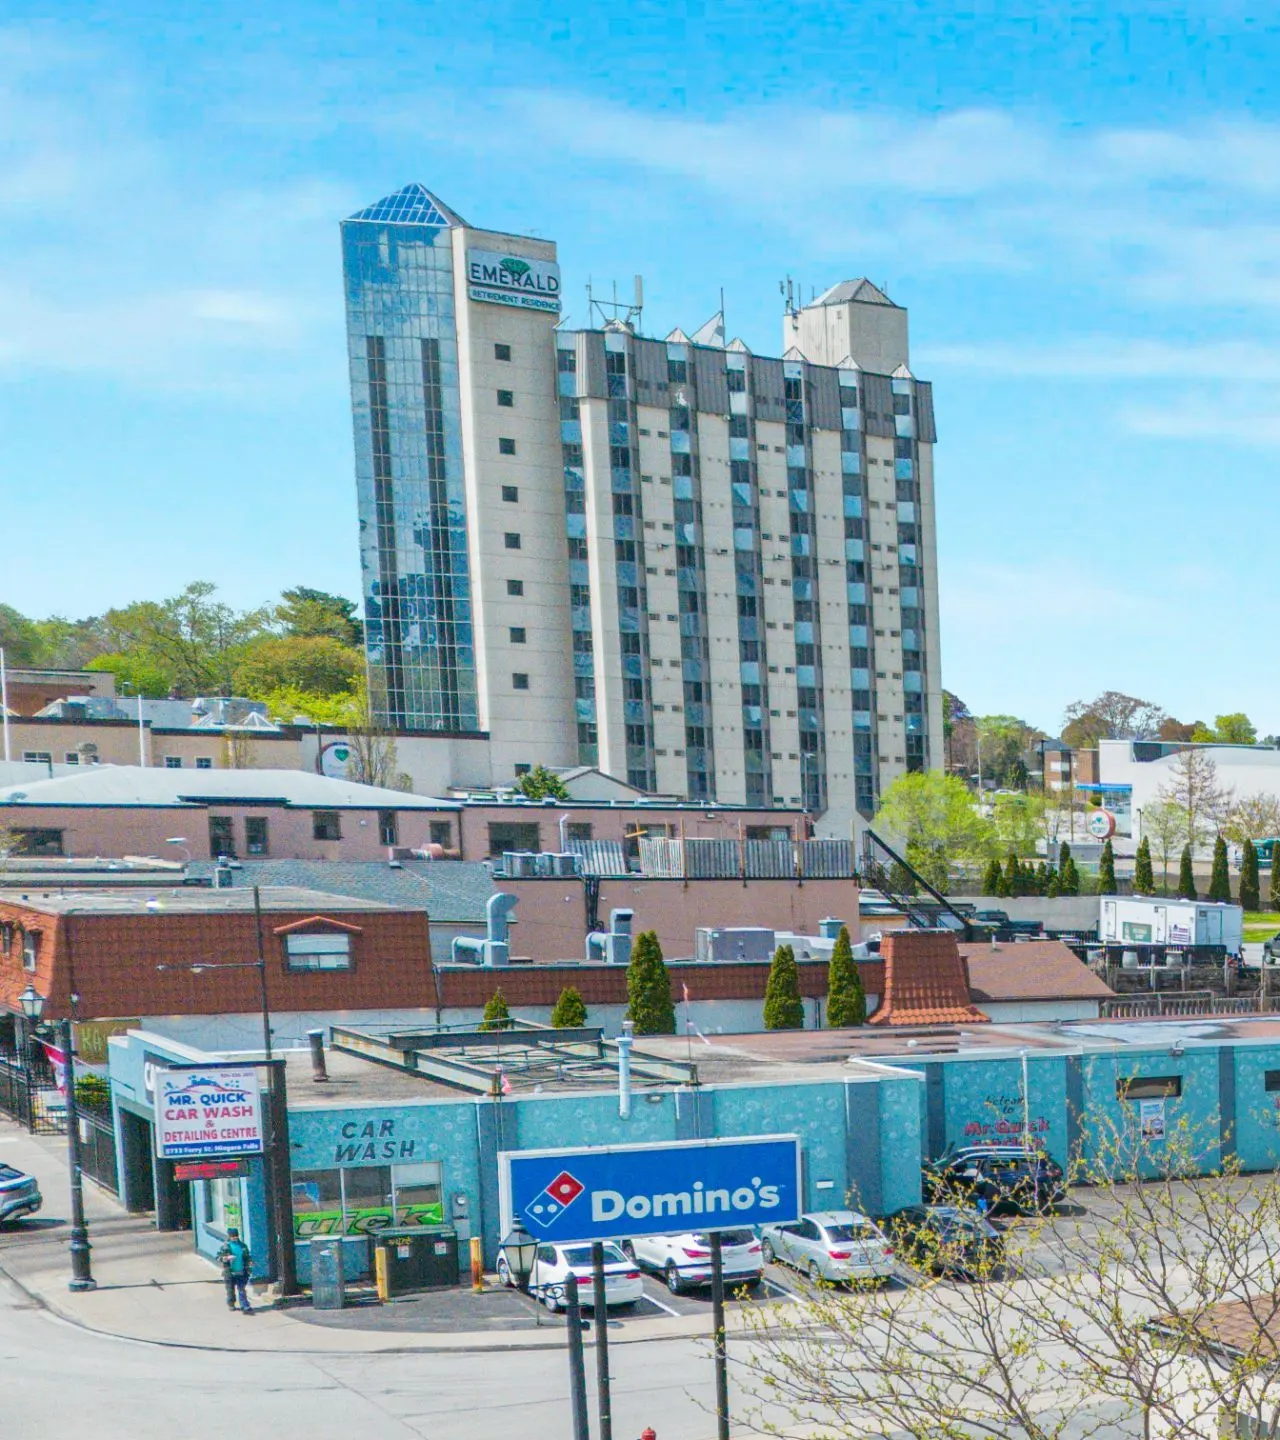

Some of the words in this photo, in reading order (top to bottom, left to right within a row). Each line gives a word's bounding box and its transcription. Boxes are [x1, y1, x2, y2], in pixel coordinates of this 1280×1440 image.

[471, 263, 559, 291] EMERALD
[169, 1095, 196, 1106] MR.
[200, 1093, 246, 1106] QUICK
[165, 1108, 199, 1121] CAR
[203, 1106, 253, 1119] WASH
[205, 1120, 215, 1128] &
[342, 1120, 395, 1139] CAR
[164, 1129, 218, 1142] DETAILING
[220, 1127, 258, 1139] CENTRE
[335, 1140, 415, 1163] WASH
[591, 1177, 781, 1222] Domino's
